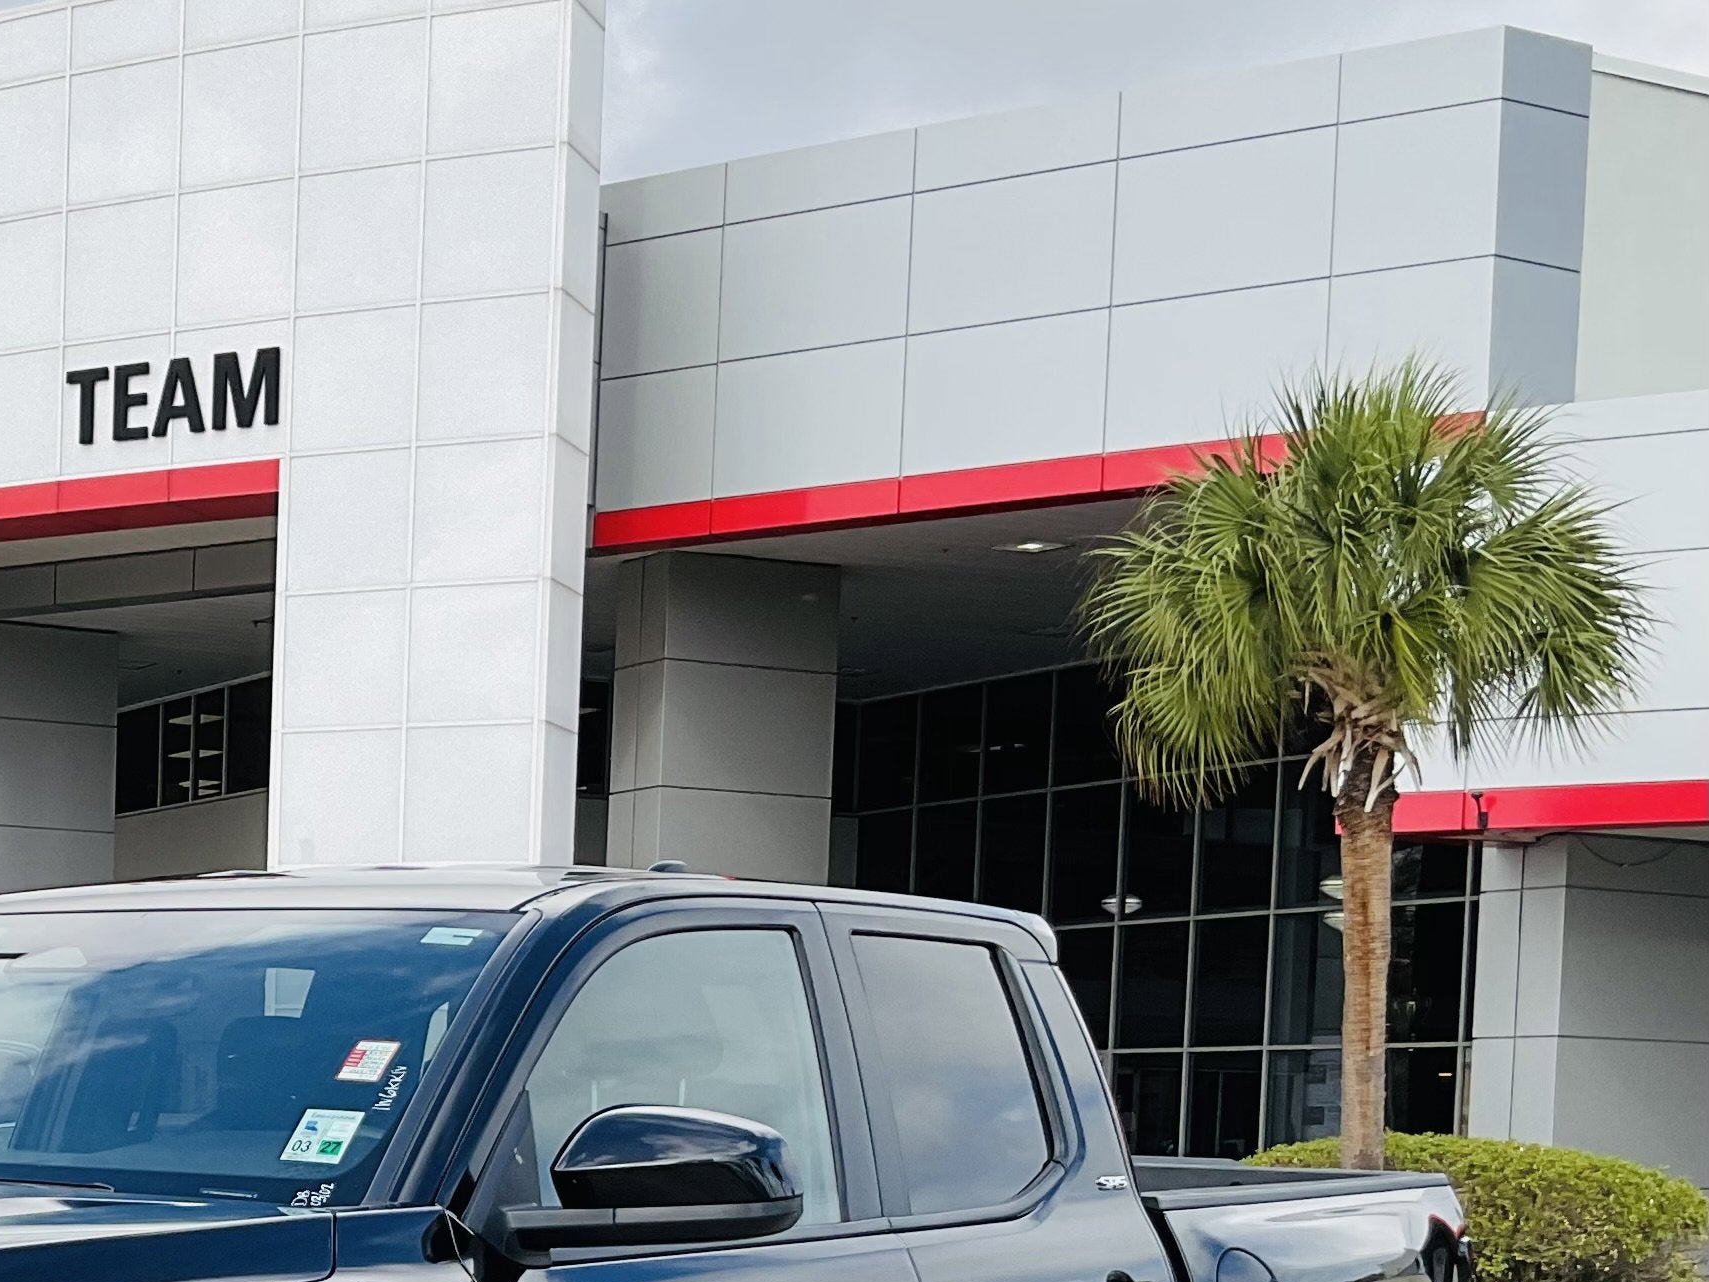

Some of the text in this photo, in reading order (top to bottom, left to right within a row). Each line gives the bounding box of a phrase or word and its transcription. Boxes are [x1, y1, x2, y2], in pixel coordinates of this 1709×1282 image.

[66, 346, 281, 445] TEAM
[291, 1139, 342, 1153] 03 27
